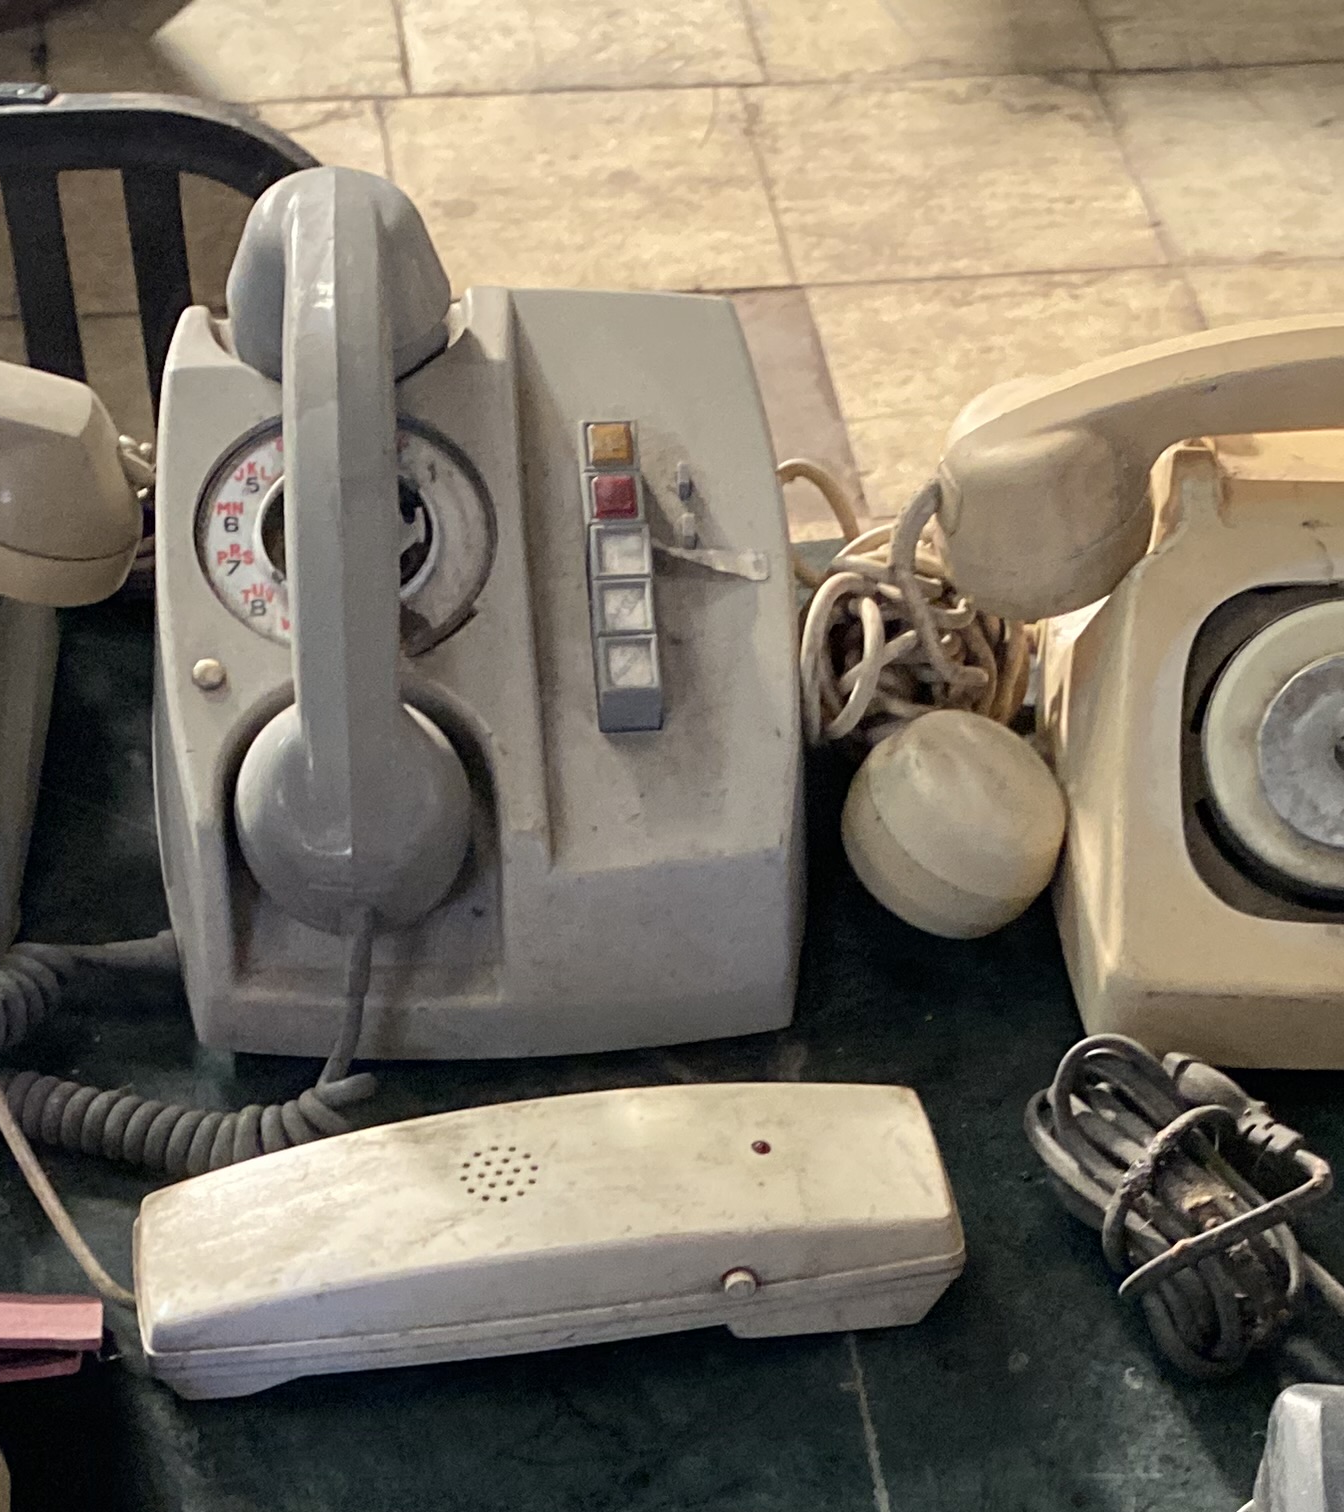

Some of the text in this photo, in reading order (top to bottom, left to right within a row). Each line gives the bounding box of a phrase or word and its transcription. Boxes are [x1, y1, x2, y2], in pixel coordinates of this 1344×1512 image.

[246, 477, 259, 493] 5
[217, 503, 243, 515] MN
[224, 517, 238, 532] 6
[226, 560, 241, 576] 7
[242, 584, 274, 603] TUV
[250, 599, 266, 617] 8
